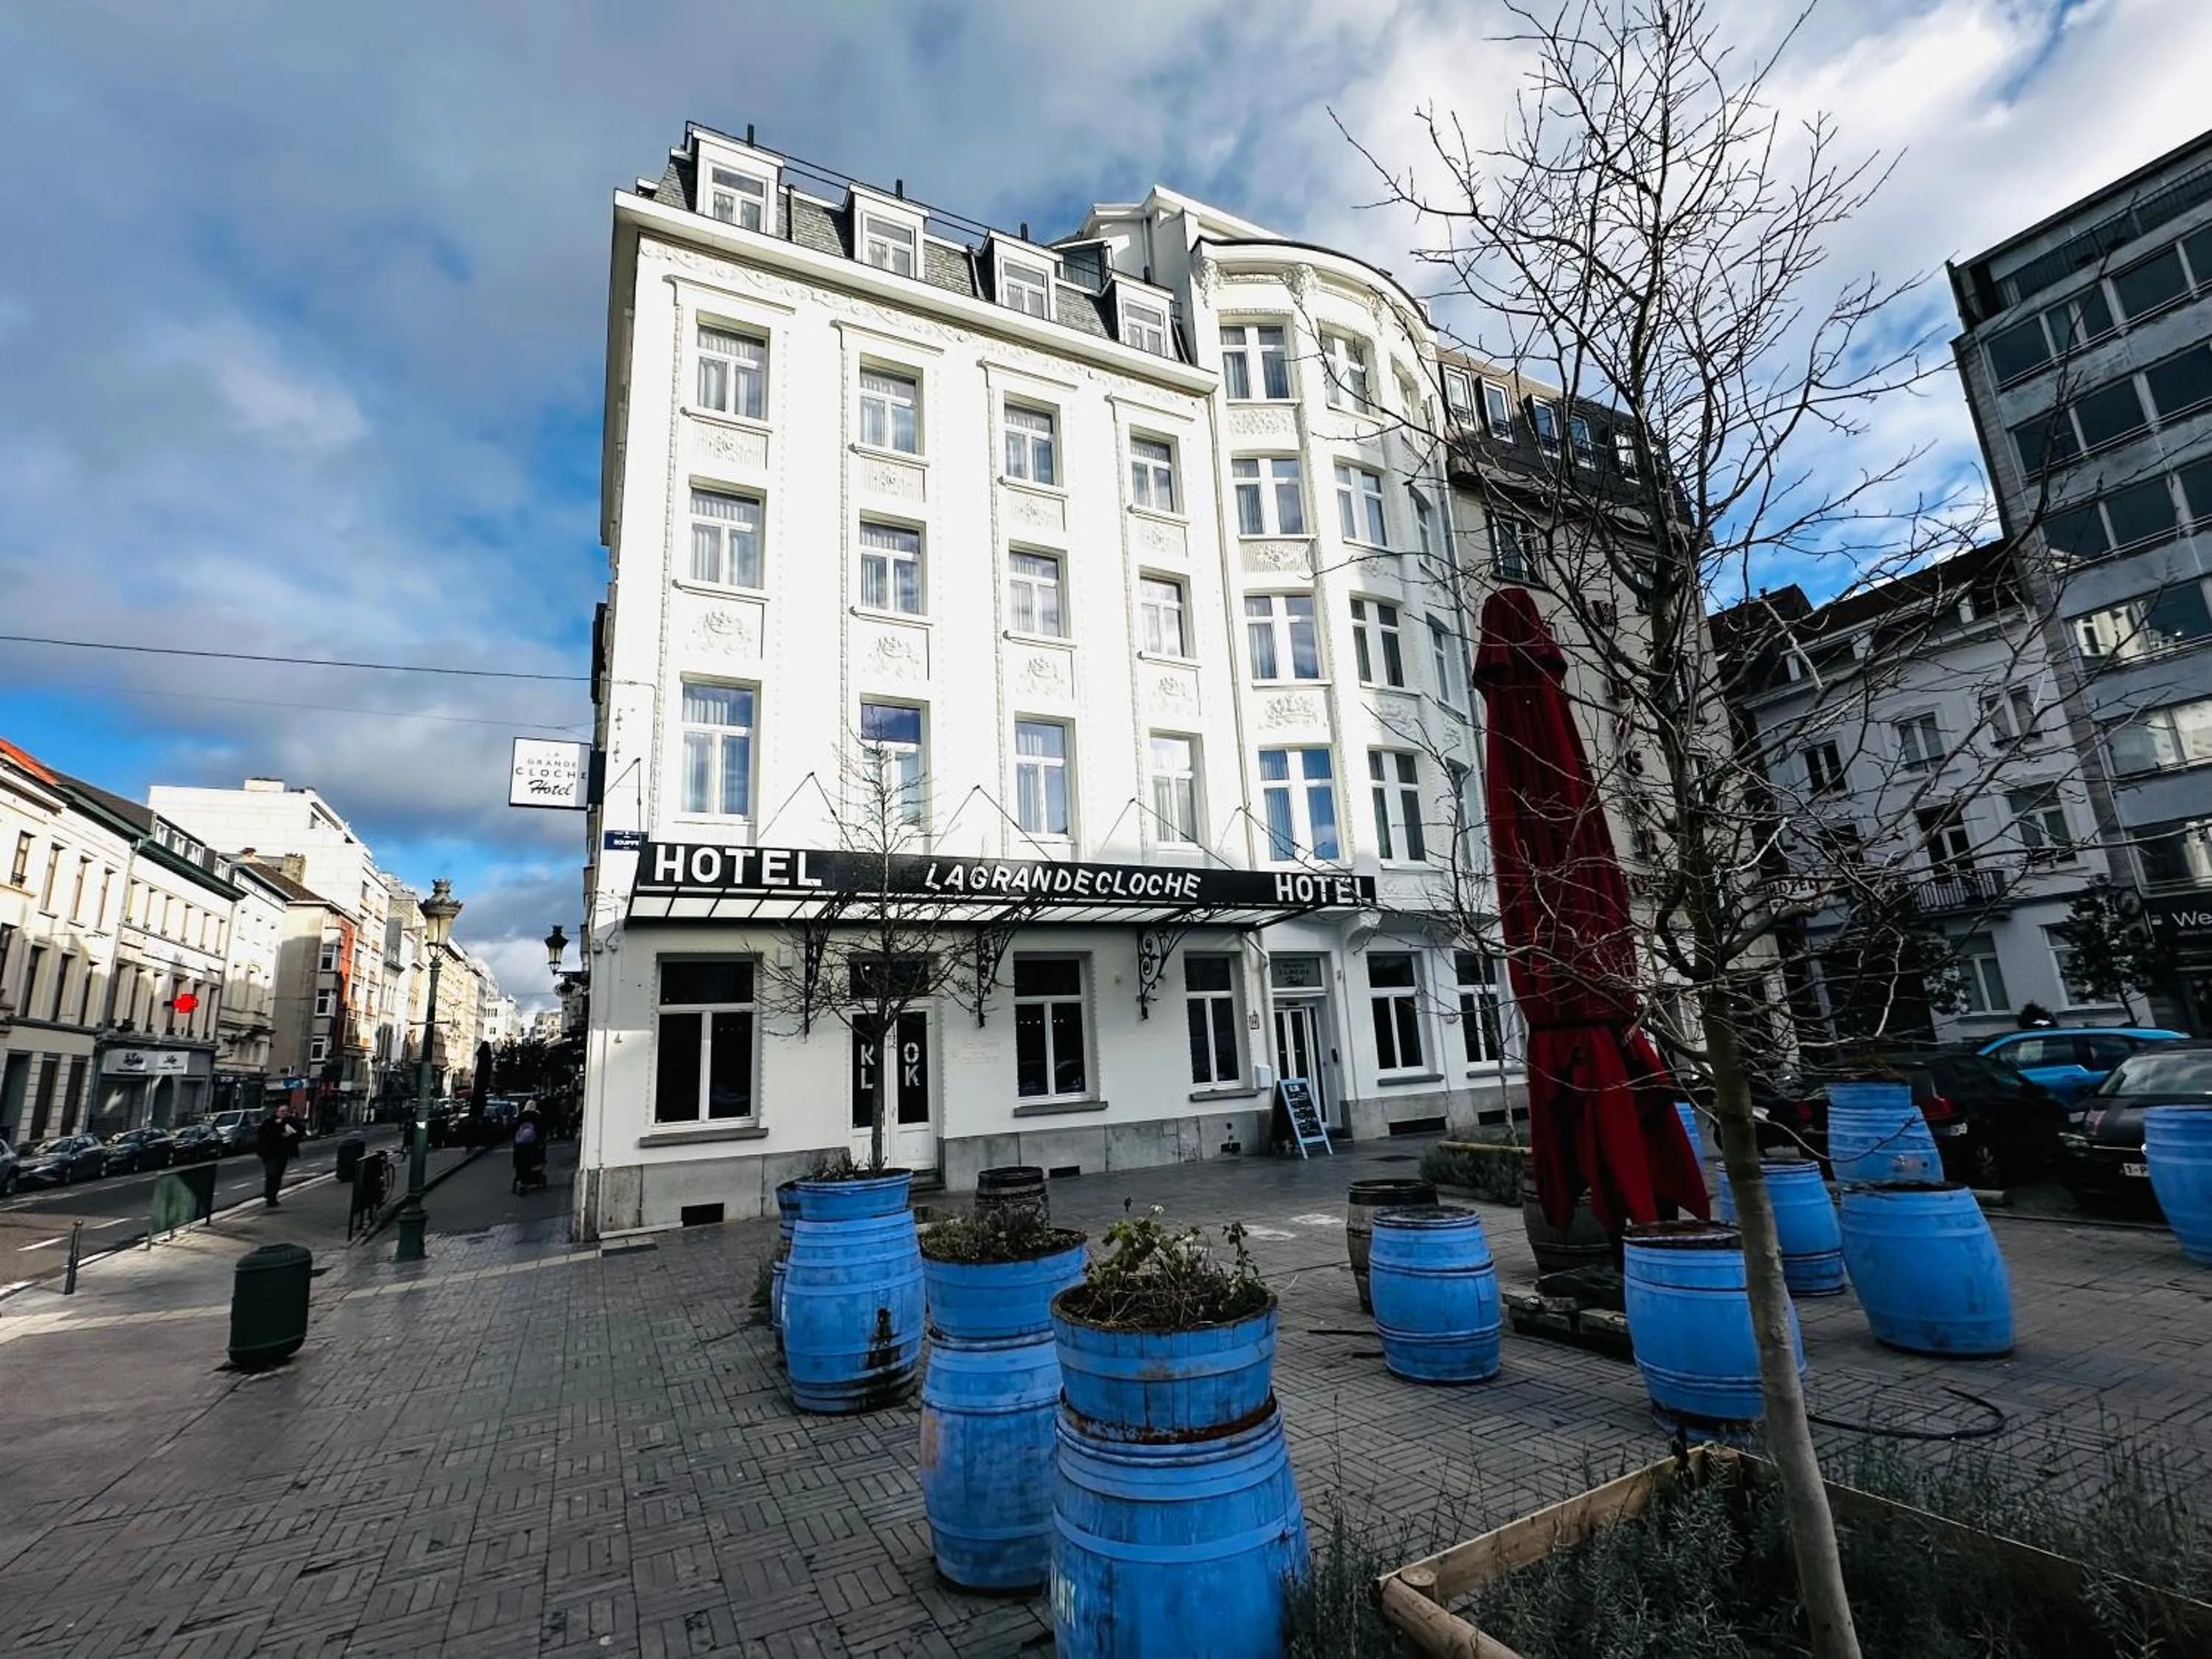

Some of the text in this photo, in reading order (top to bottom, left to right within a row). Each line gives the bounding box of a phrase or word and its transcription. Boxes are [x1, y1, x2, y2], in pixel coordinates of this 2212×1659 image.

[528, 779, 574, 796] Hotel
[654, 844, 822, 887] HOTEL
[1274, 873, 1372, 905] HOTEL
